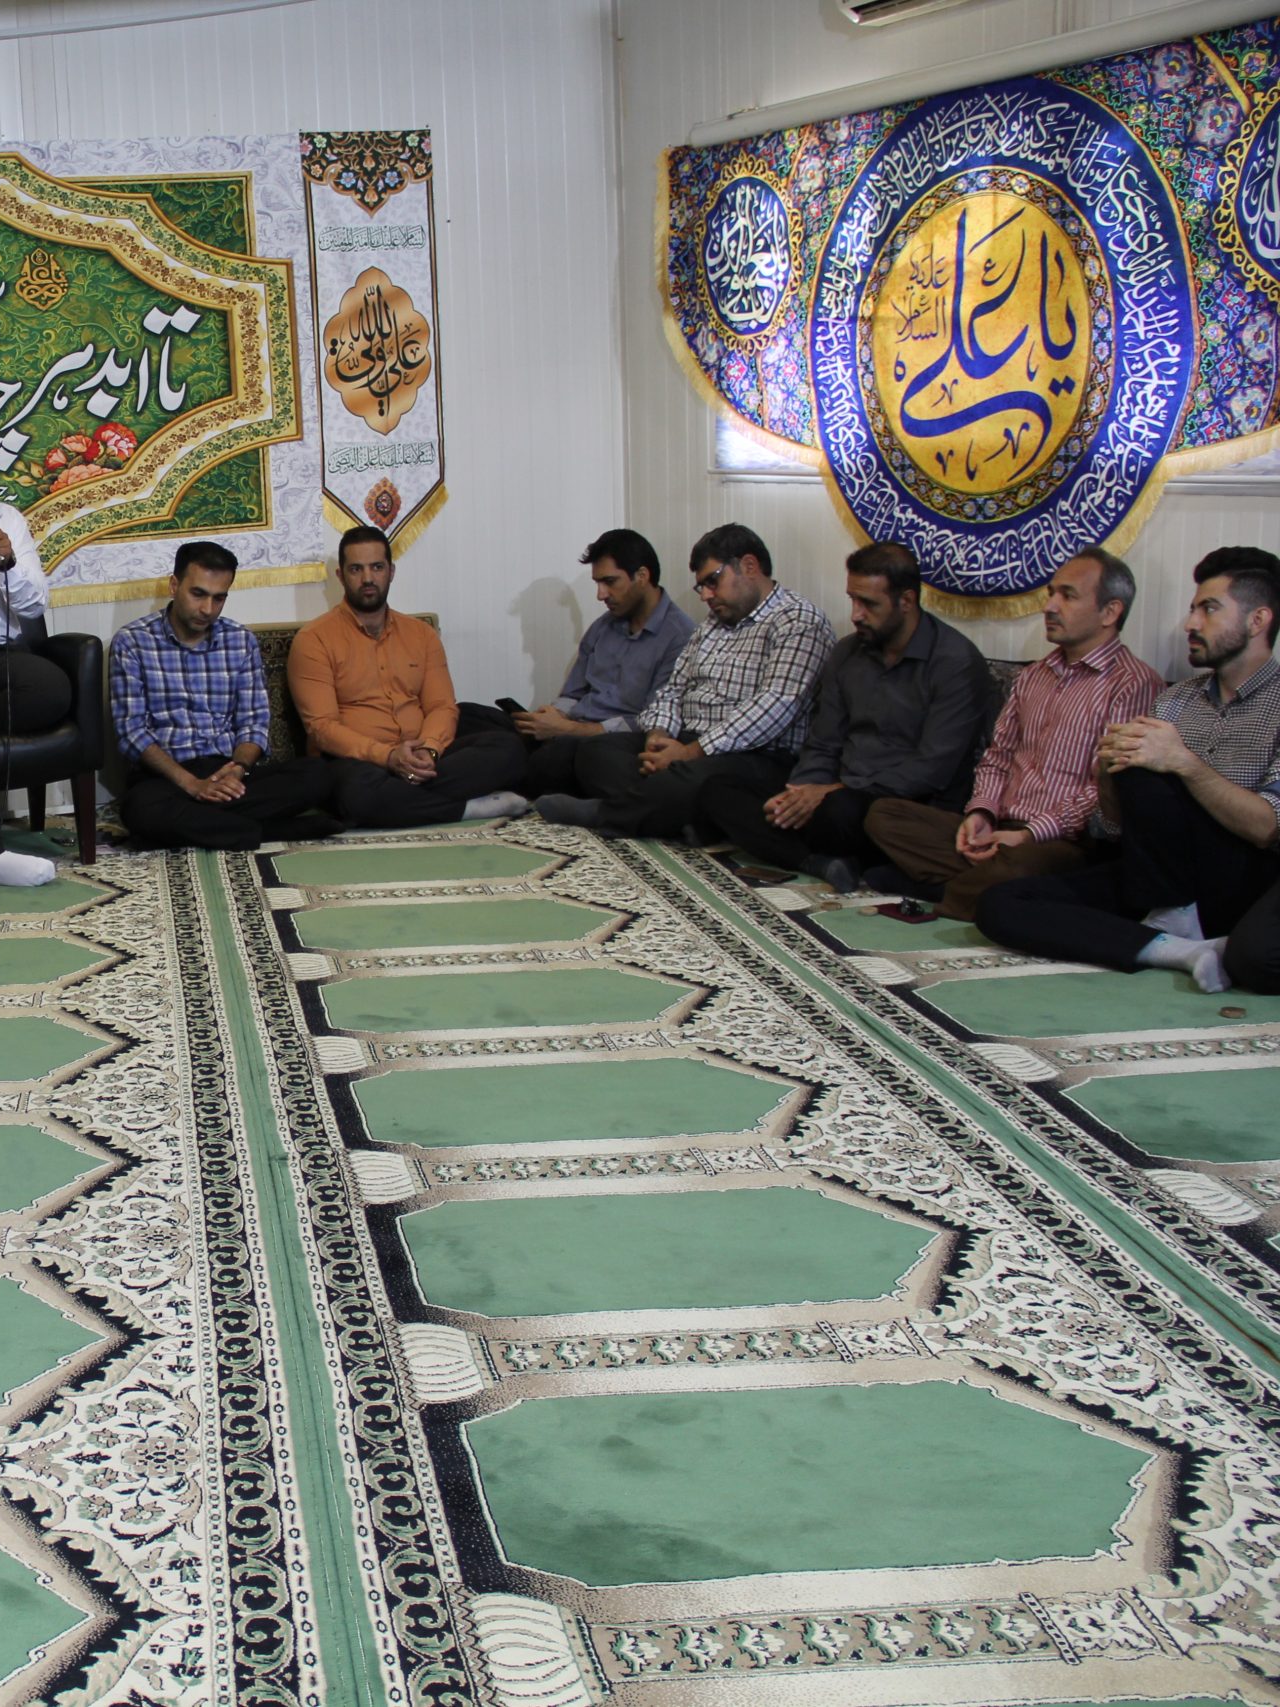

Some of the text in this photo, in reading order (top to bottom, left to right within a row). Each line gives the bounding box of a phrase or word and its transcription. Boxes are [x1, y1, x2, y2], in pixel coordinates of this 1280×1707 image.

[0, 344, 95, 431] هر
[73, 348, 149, 419] ابد
[143, 305, 201, 411] تا
